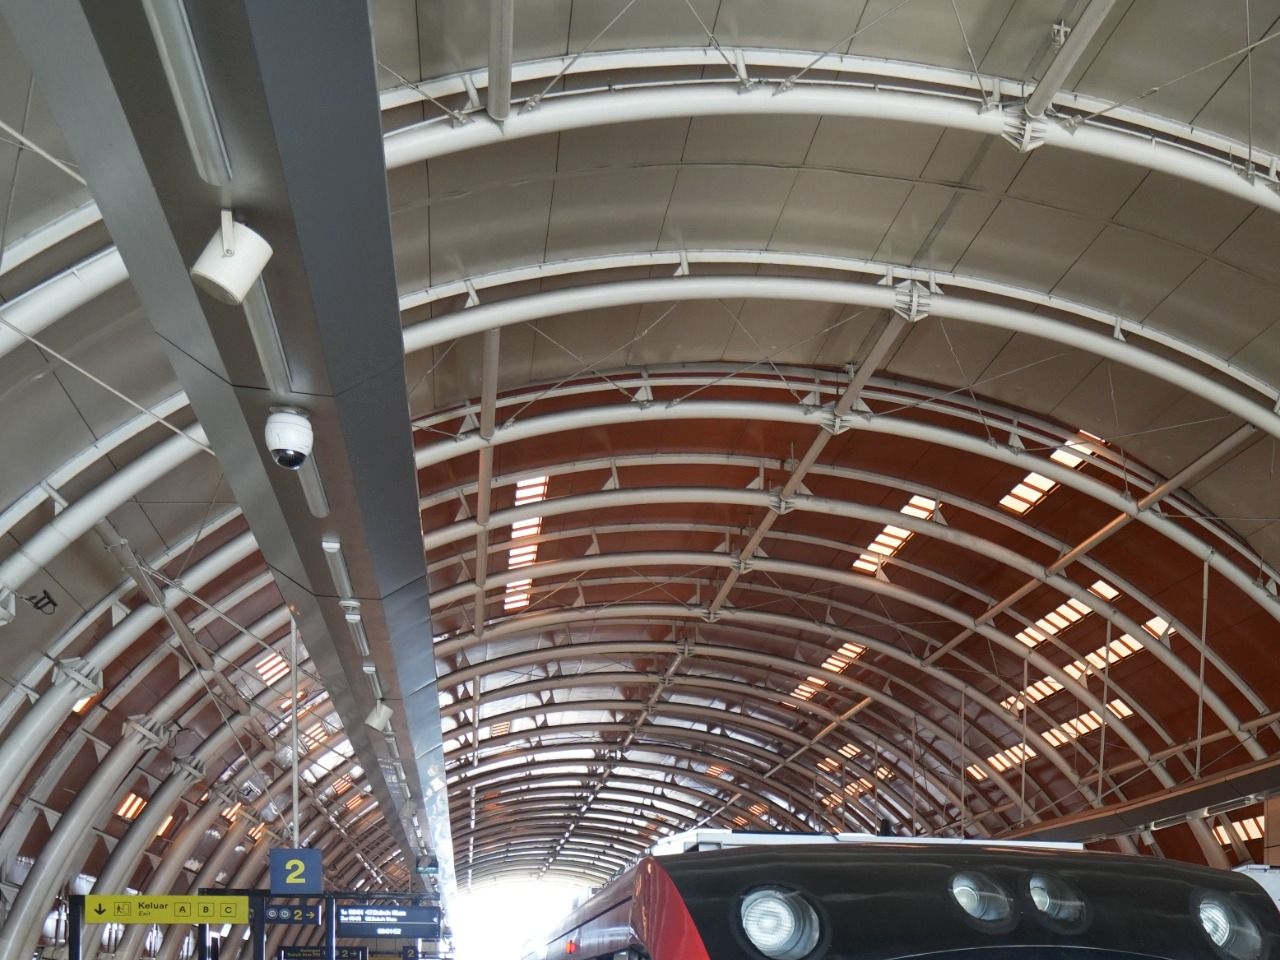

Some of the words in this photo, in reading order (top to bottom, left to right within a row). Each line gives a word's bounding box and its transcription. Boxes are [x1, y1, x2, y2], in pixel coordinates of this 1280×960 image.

[285, 859, 306, 884] 2
[138, 902, 169, 910] Keluar
[224, 906, 232, 914] C
[294, 911, 303, 921] 2
